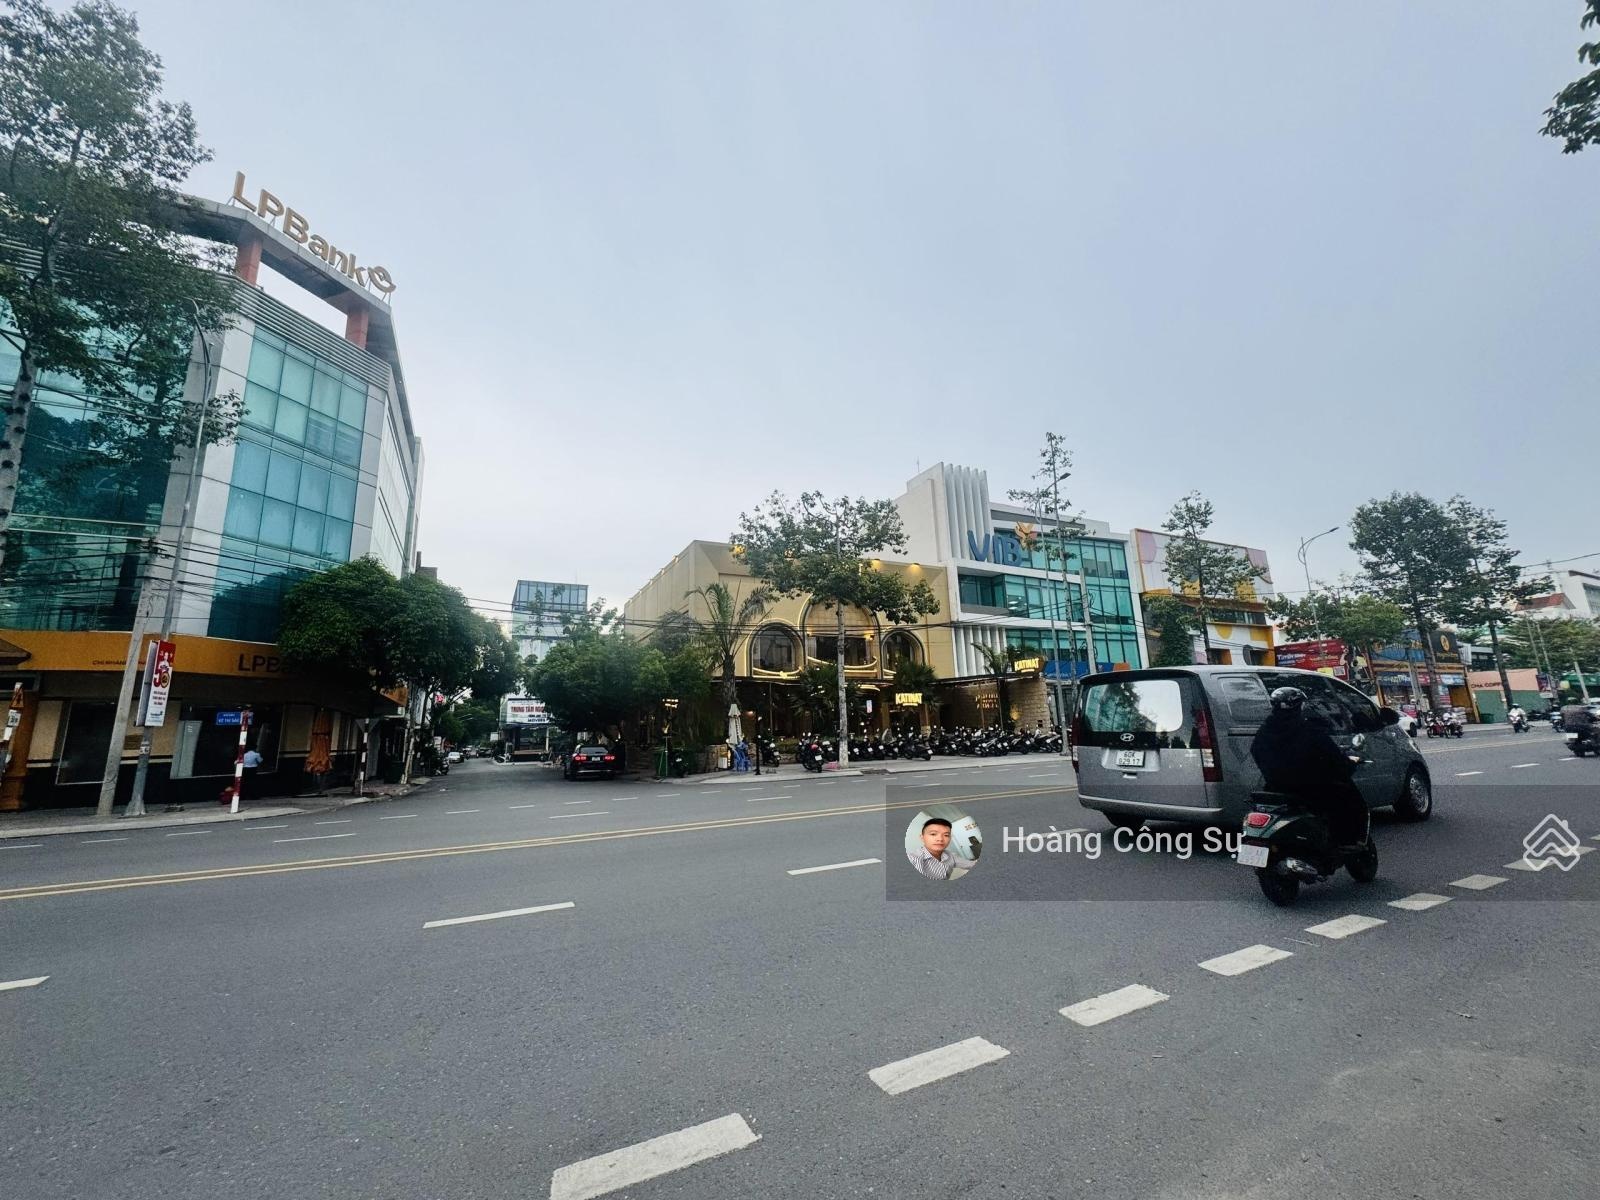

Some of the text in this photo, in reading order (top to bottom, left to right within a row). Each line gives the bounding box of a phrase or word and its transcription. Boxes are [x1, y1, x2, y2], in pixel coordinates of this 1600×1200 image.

[233, 170, 367, 288] LPBank
[967, 530, 1021, 567] VIB
[1014, 657, 1039, 671] KATINAT
[895, 693, 923, 705] KATINAT
